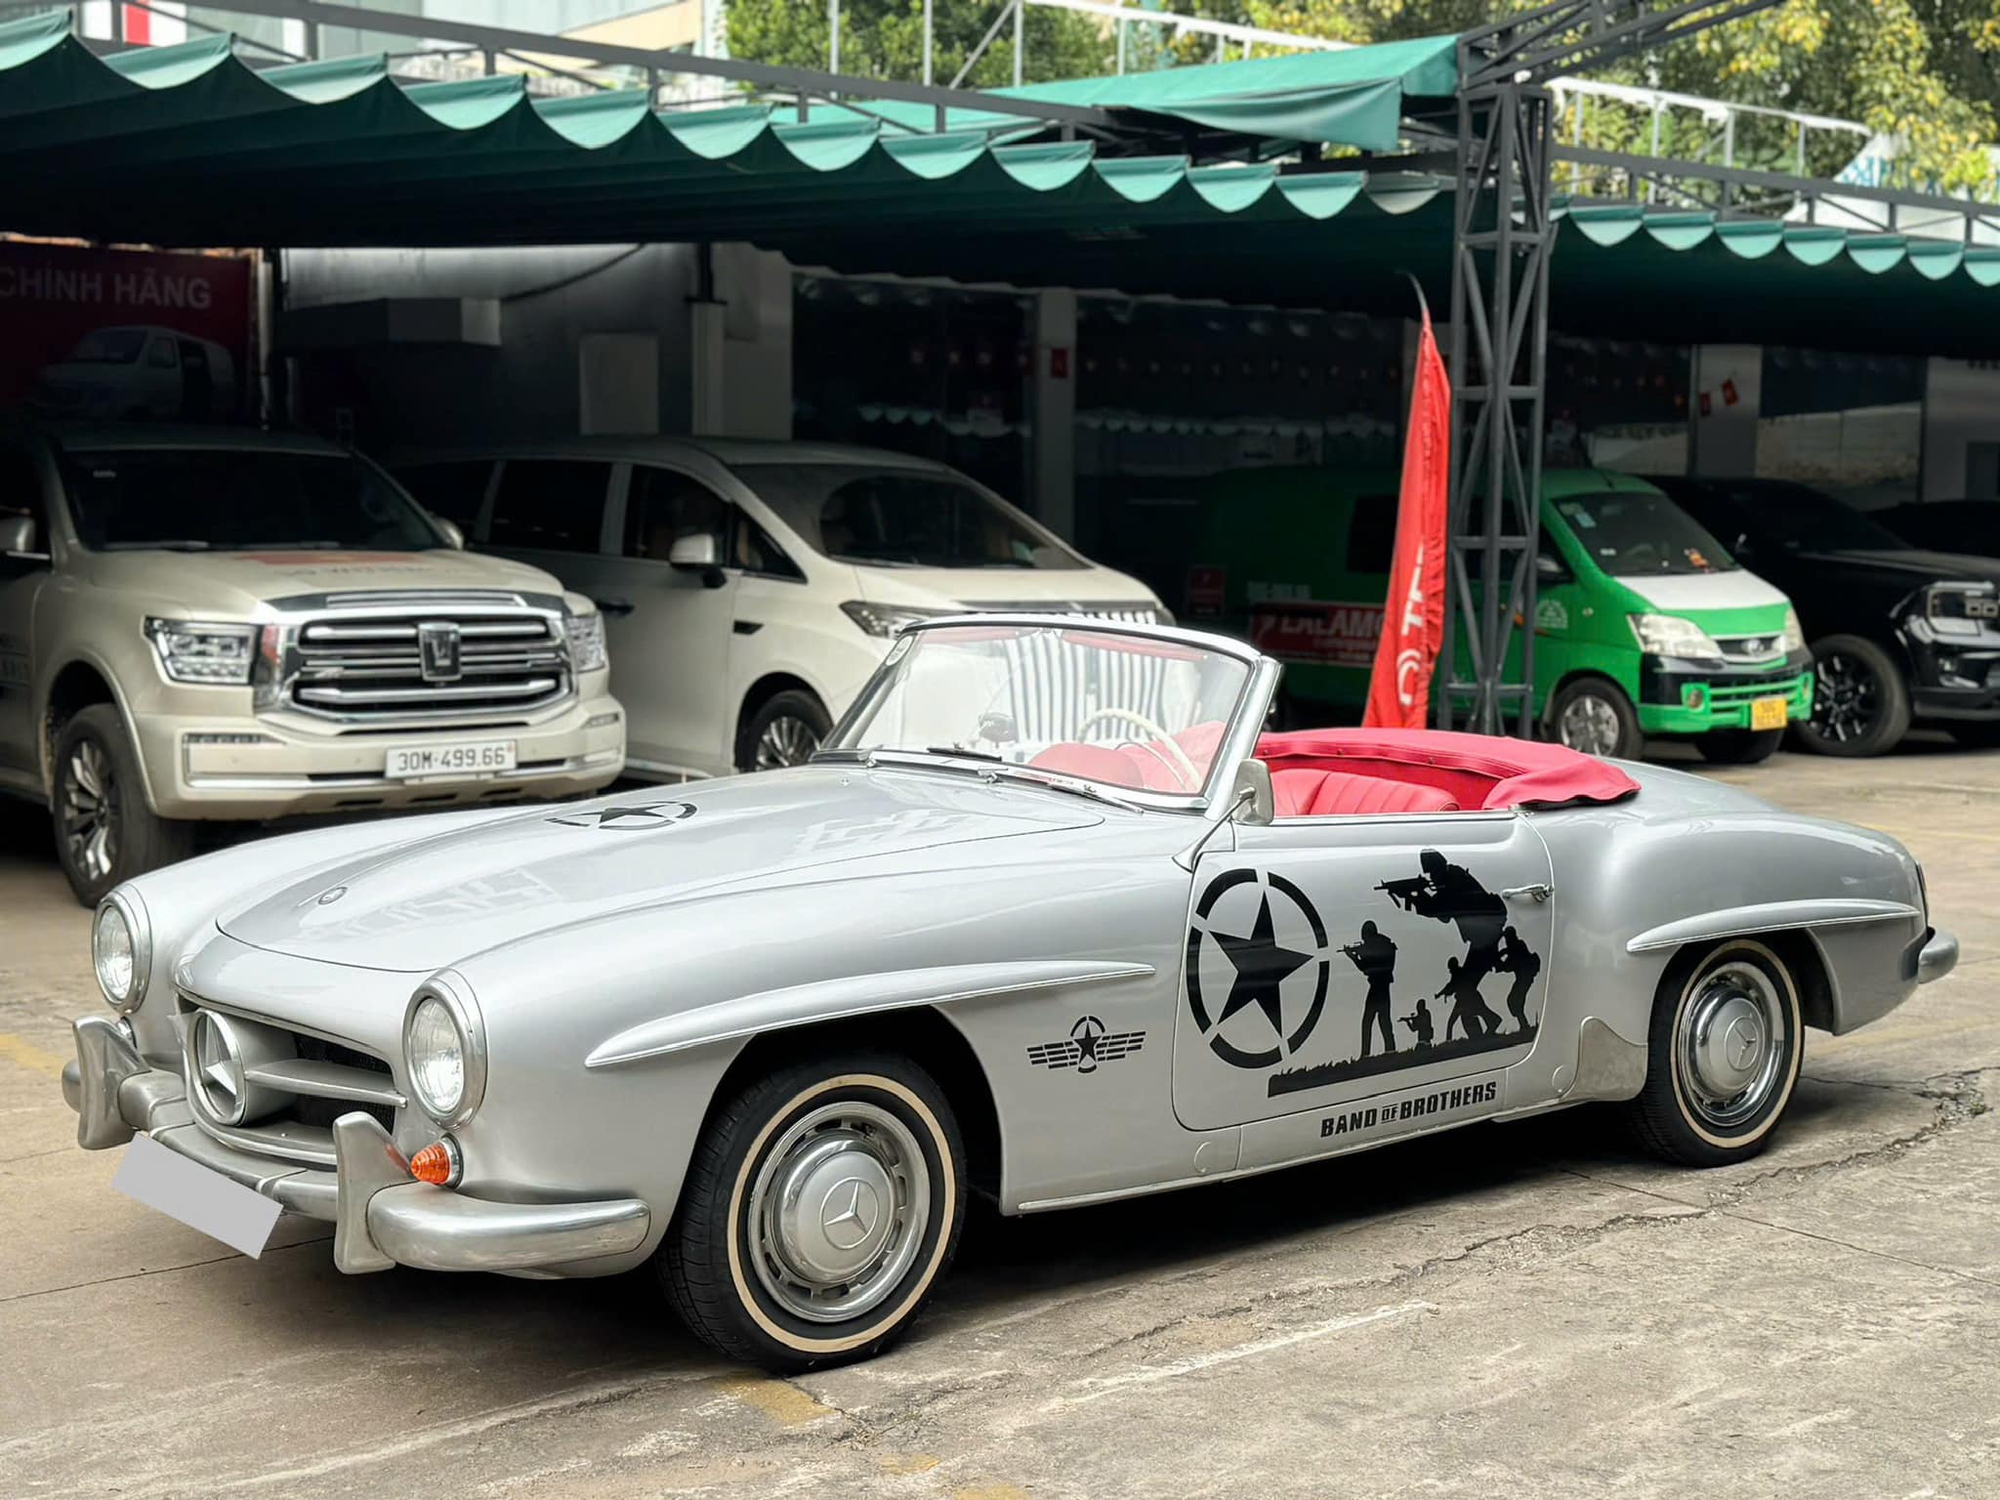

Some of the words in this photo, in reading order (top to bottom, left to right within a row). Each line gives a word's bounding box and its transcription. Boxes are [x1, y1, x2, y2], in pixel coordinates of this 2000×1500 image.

[114, 267, 212, 310] HÃNG
[1320, 1108, 1377, 1138] BAND
[1381, 1105, 1398, 1122] OF
[1399, 1081, 1497, 1120] BROTHERS
